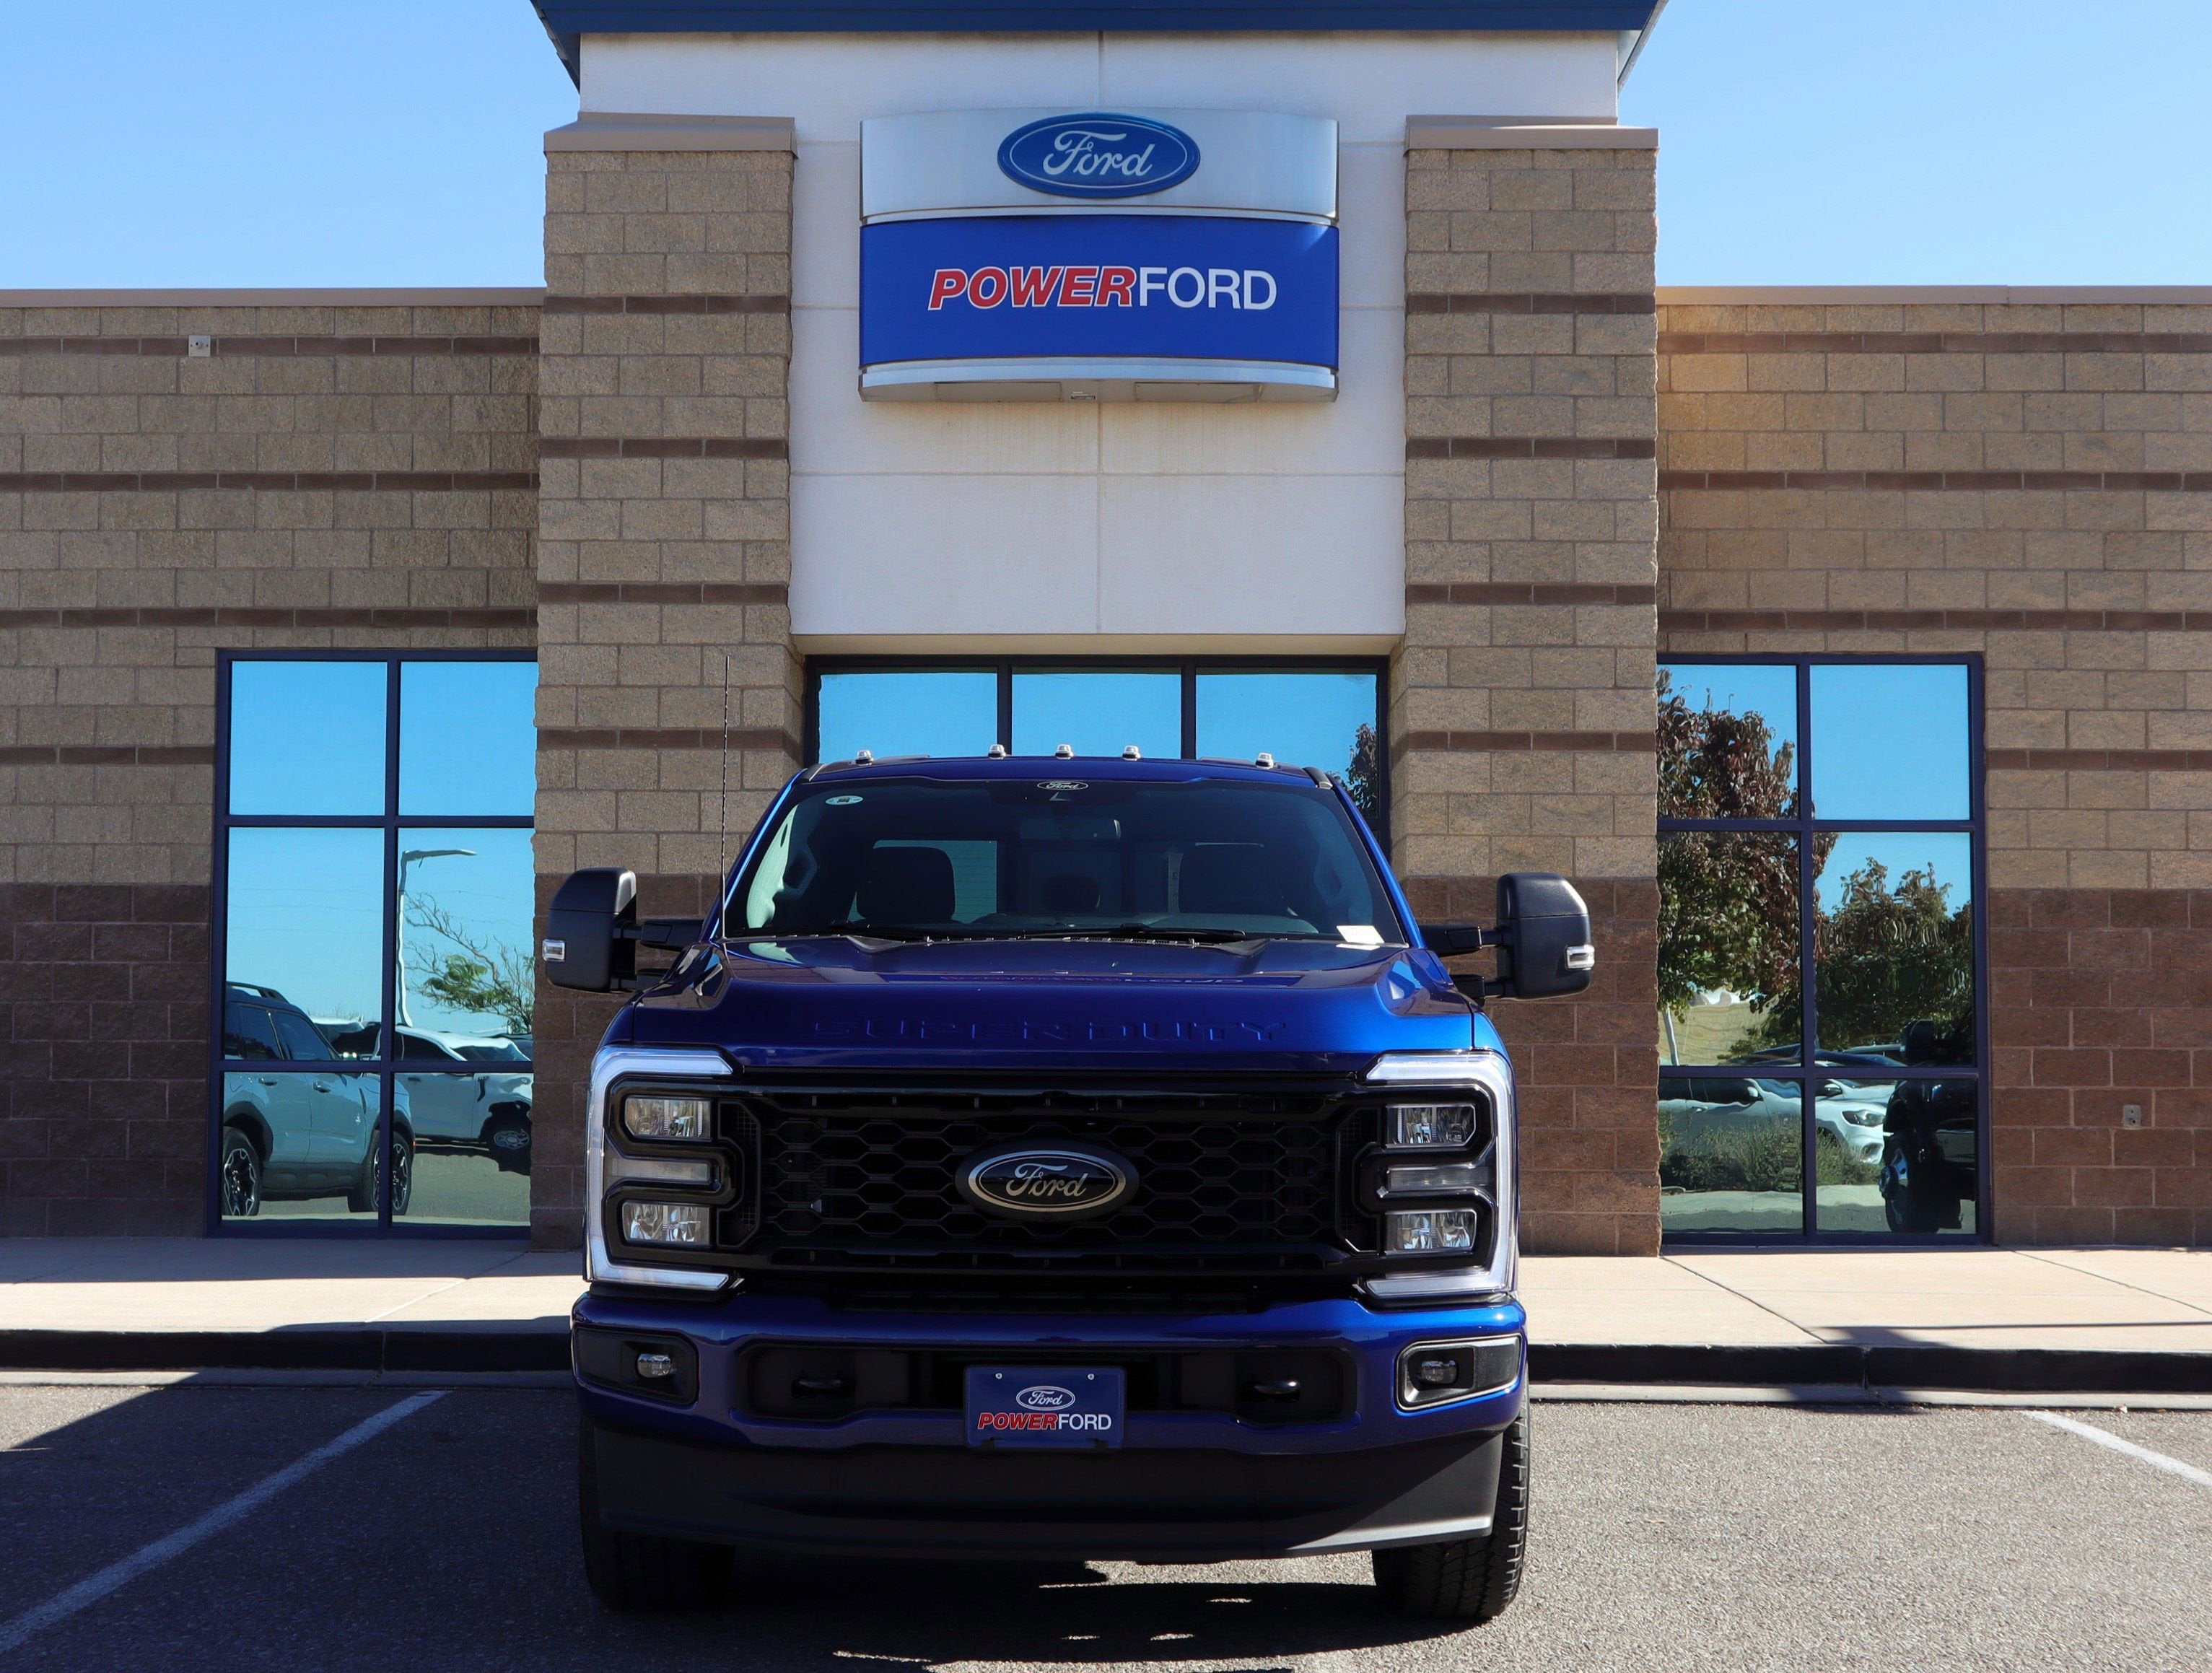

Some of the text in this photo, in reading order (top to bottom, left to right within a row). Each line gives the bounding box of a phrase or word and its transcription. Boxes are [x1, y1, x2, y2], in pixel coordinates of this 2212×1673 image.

[1042, 129, 1155, 177] Ford
[1046, 781, 1080, 790] Ford
[814, 1018, 1287, 1041] SUPER DUTY
[1005, 1163, 1088, 1197] Ford
[1028, 1390, 1063, 1405] Ford
